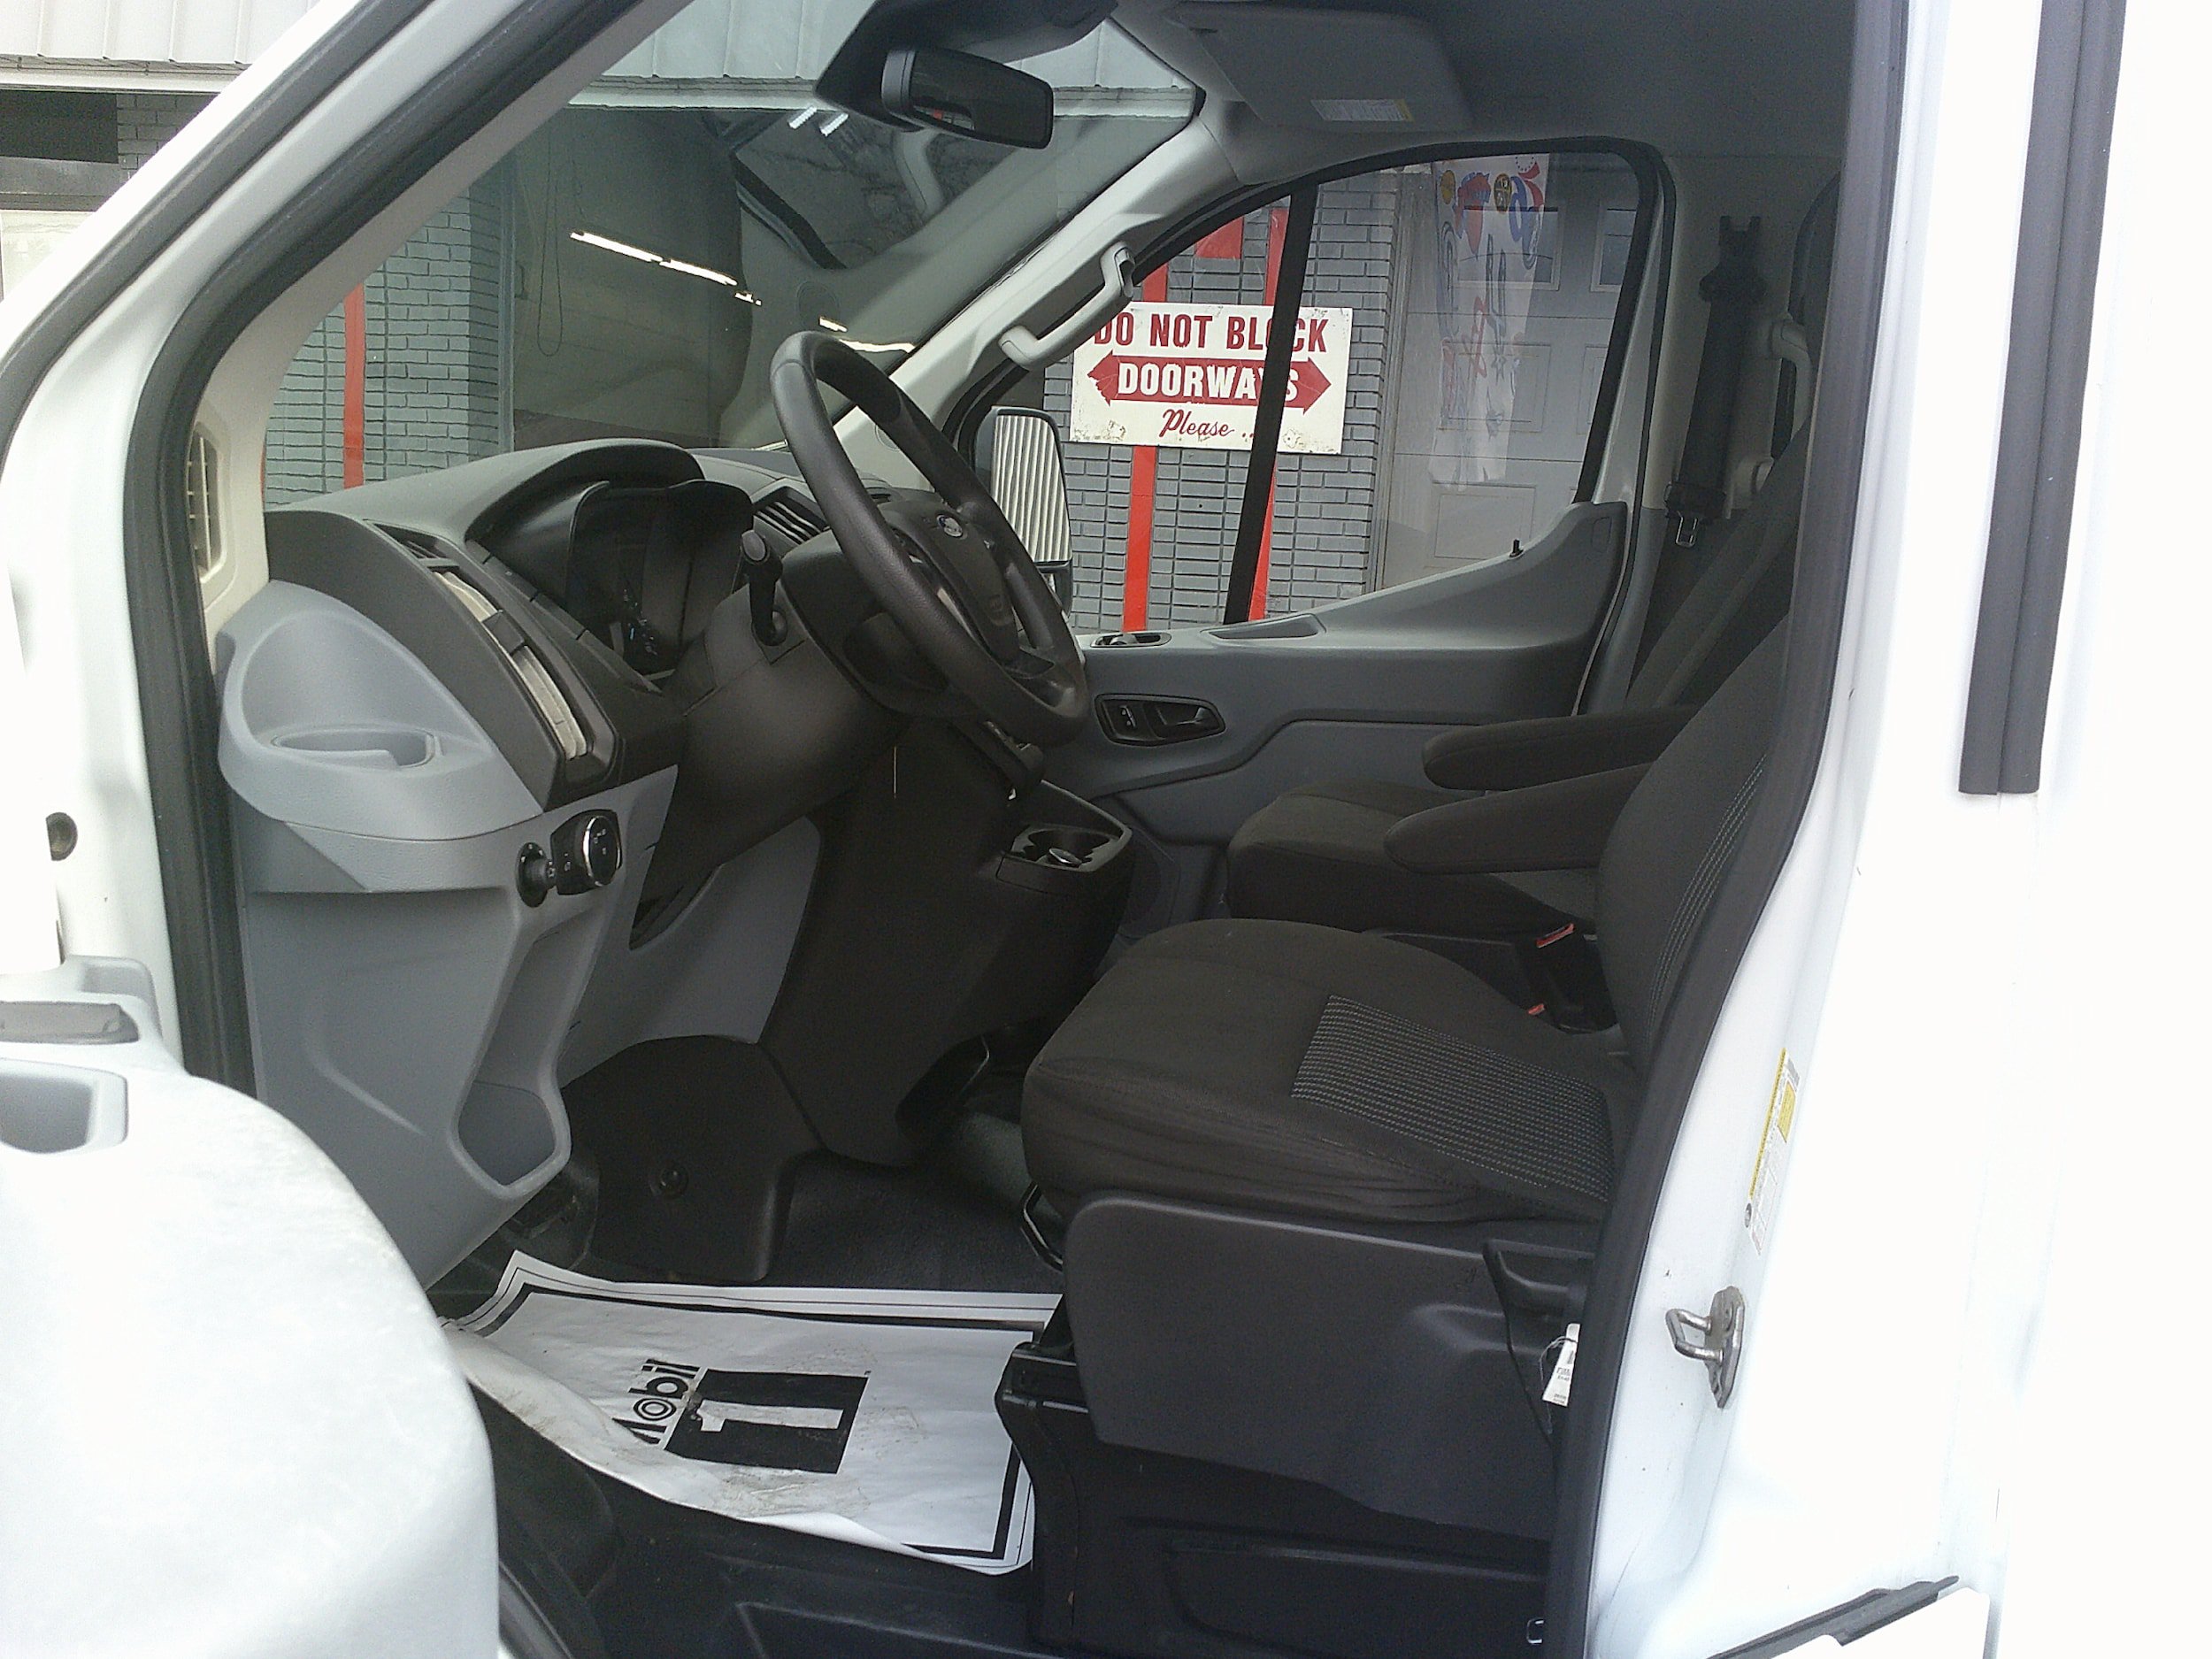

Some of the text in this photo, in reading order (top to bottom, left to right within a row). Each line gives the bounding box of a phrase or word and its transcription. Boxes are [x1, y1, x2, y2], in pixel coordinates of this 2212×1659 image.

[1149, 313, 1213, 349] NOT
[1225, 316, 1329, 353] BLCK
[1118, 362, 1300, 403] DOORWAS
[696, 1398, 844, 1432] 1
